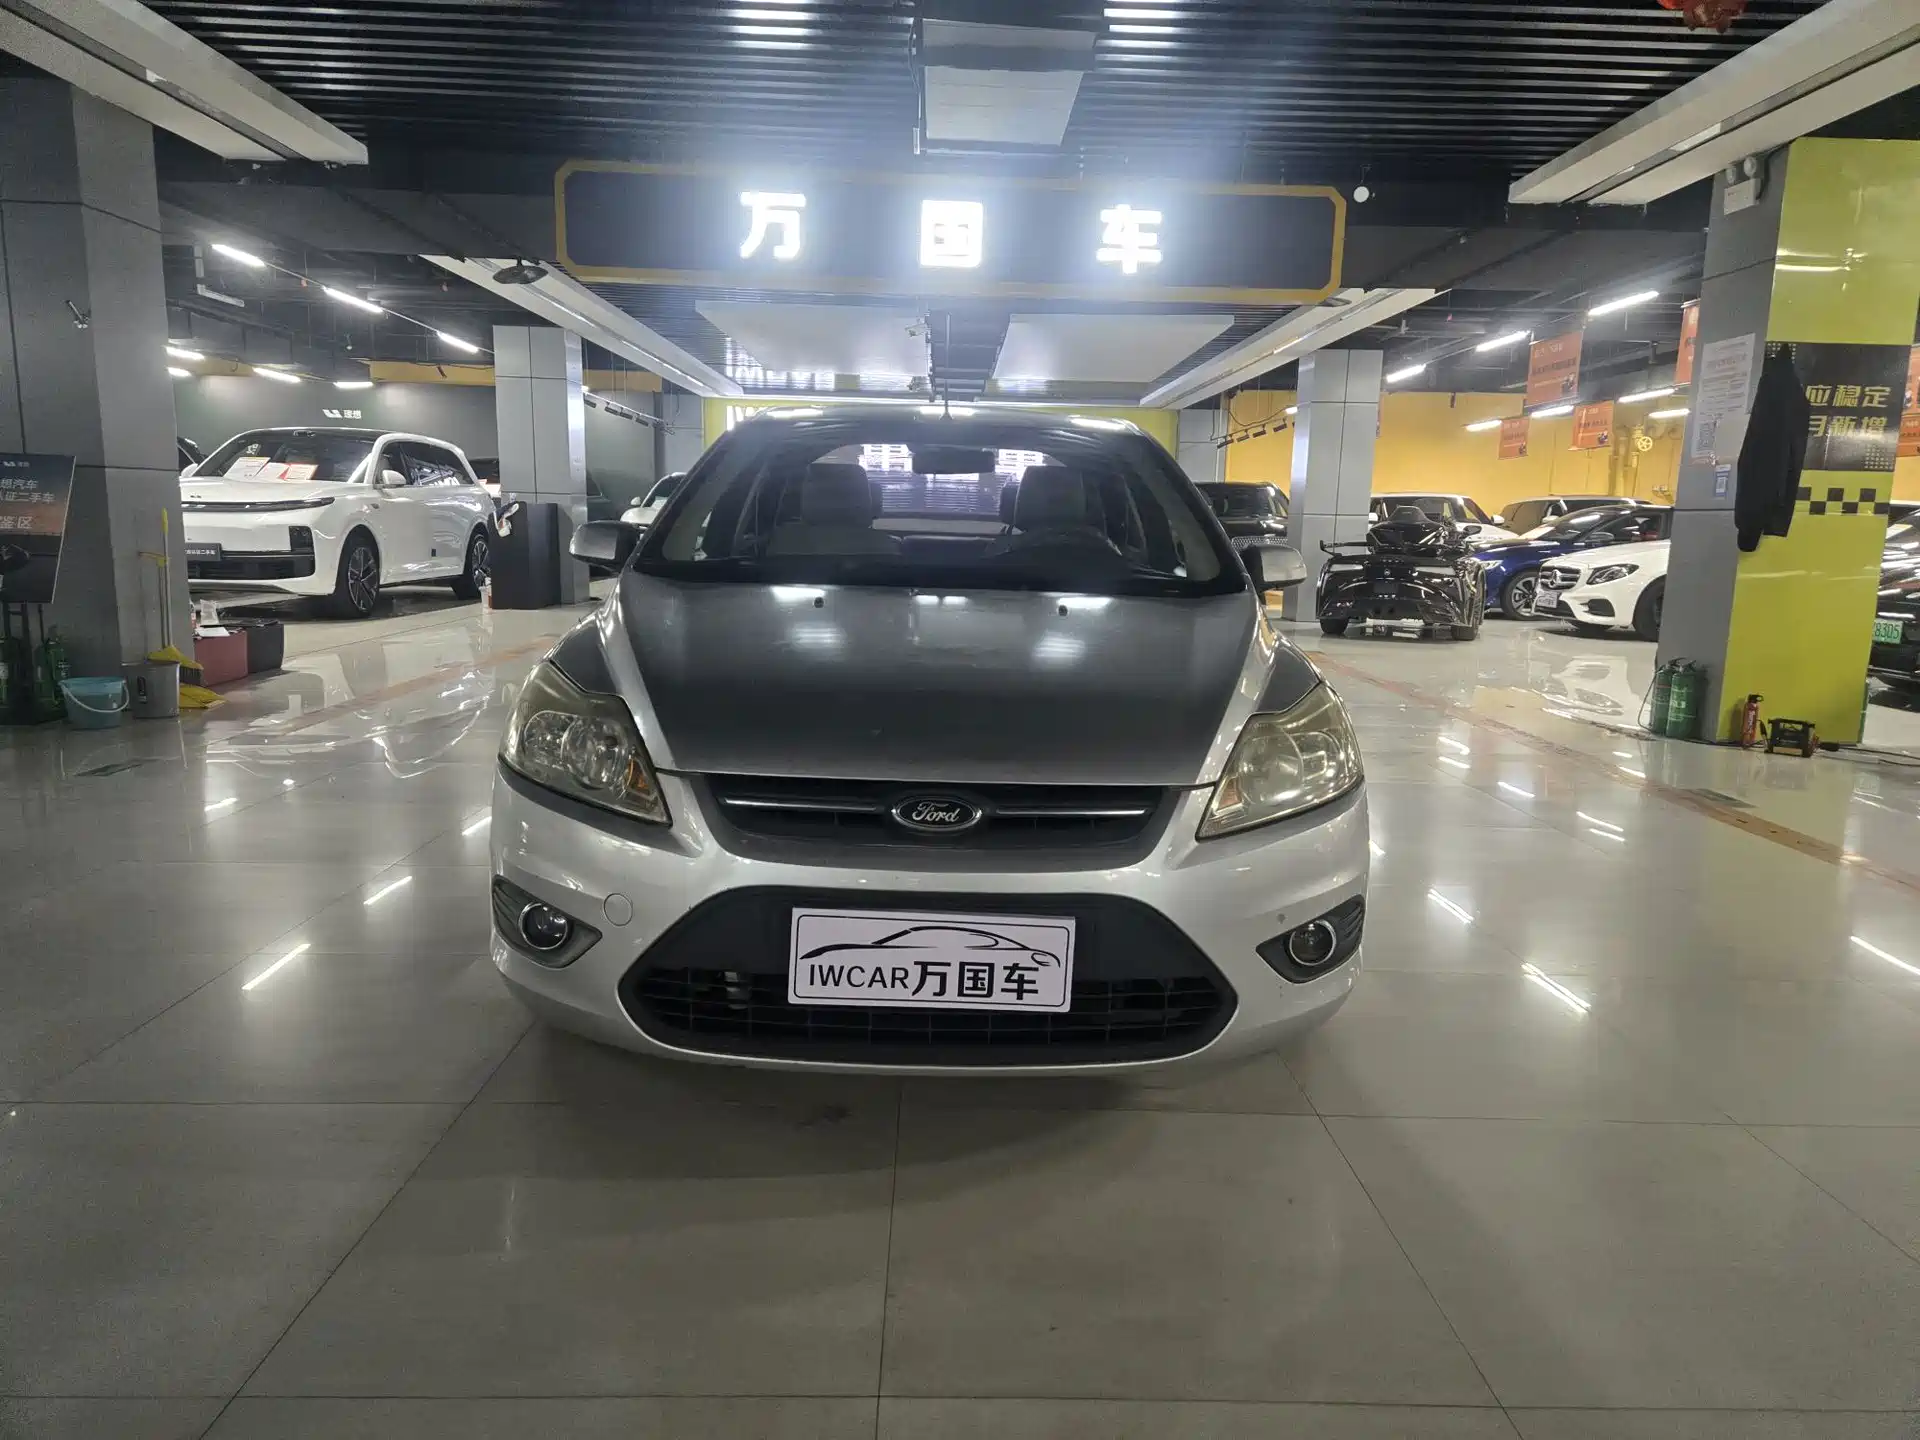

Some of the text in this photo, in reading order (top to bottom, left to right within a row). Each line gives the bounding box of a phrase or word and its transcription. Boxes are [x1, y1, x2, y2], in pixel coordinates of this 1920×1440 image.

[740, 191, 1162, 274] 万国车
[1805, 384, 1891, 408] 应稳定
[912, 801, 961, 822] Ford
